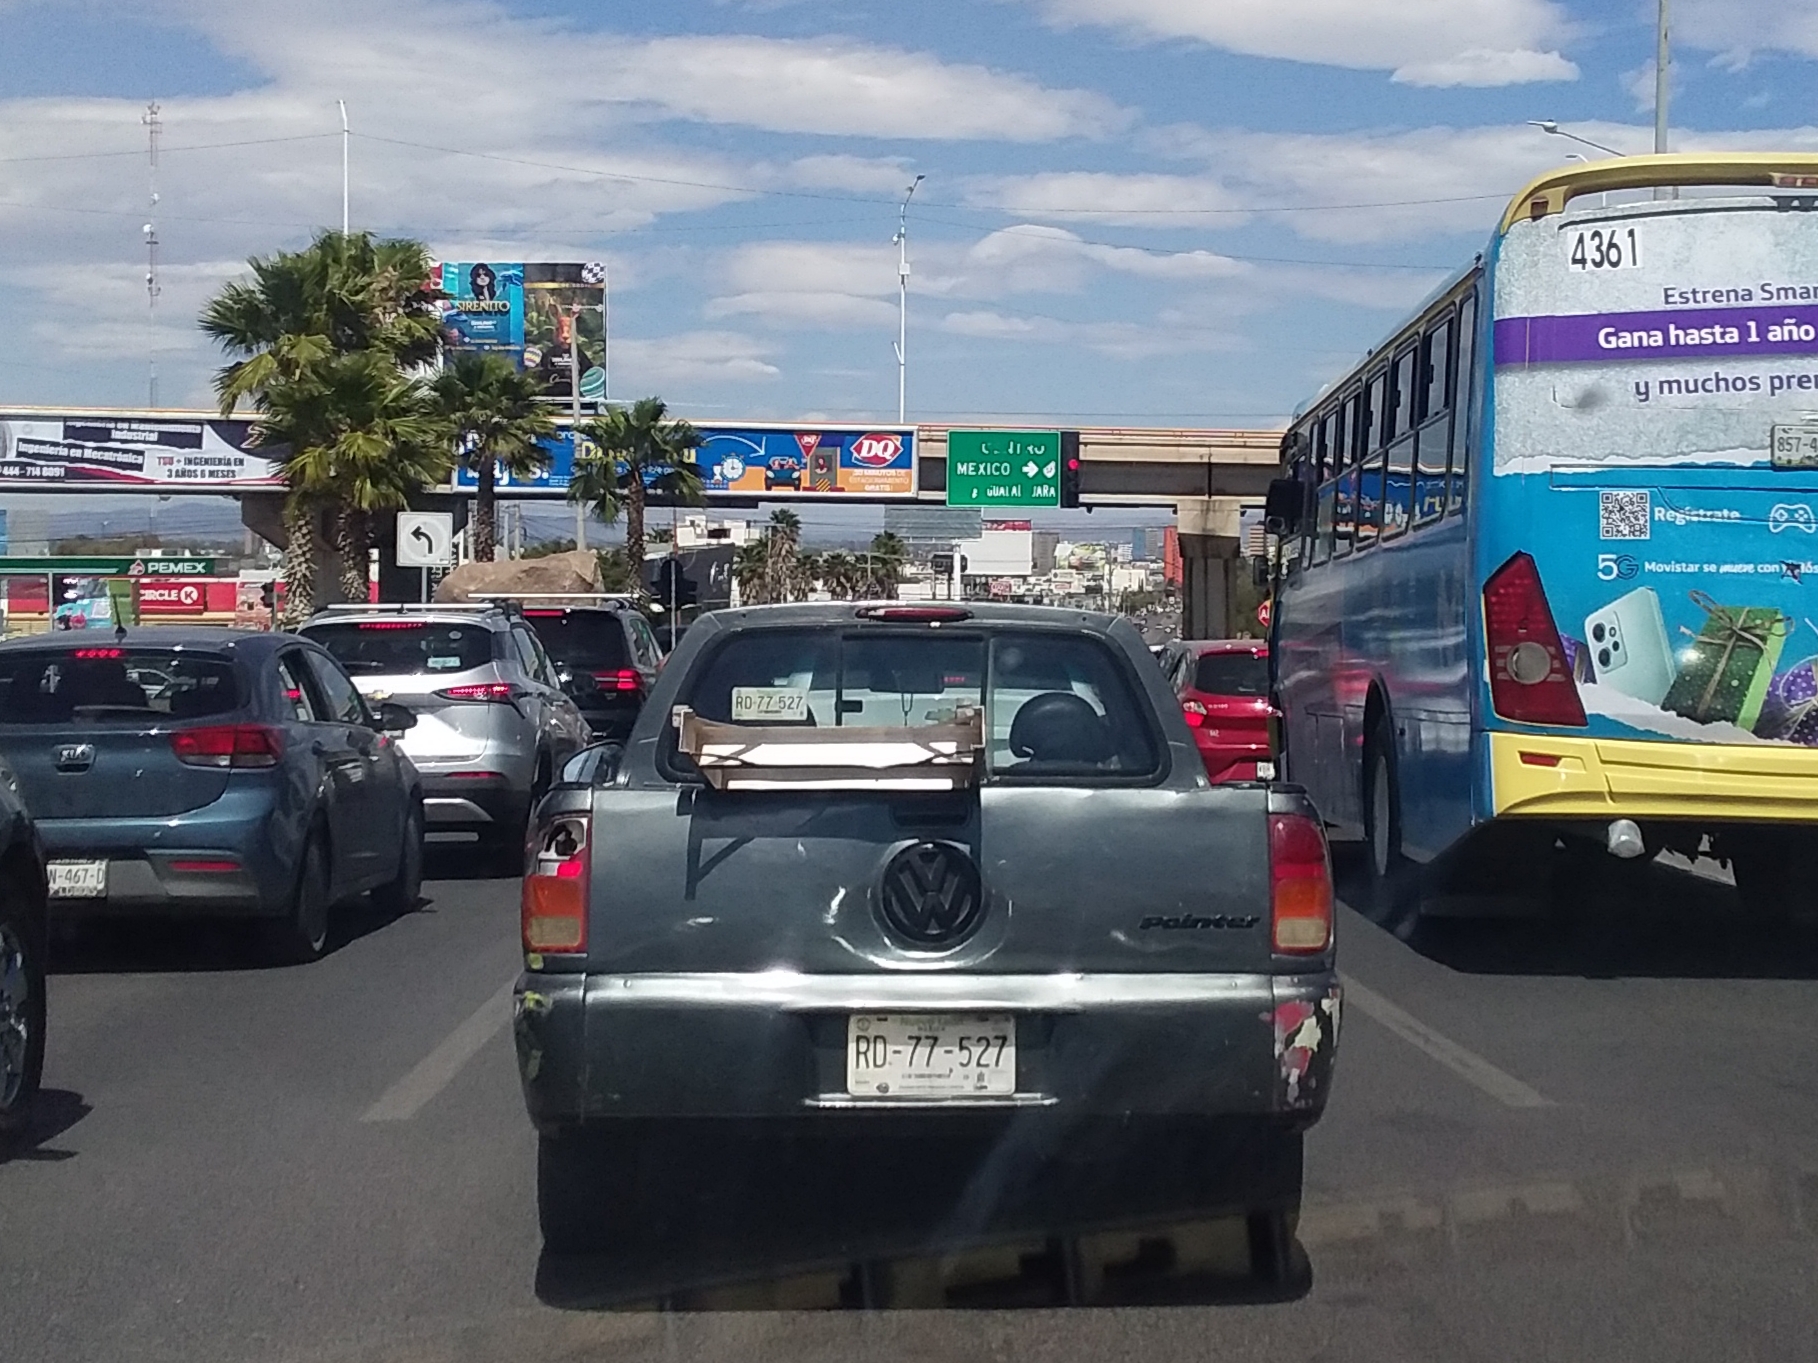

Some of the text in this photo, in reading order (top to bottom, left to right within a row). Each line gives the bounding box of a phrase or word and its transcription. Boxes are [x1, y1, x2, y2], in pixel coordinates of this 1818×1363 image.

[1571, 228, 1638, 270] 4361
[1663, 286, 1753, 305] Estrena
[456, 301, 510, 312] SIRENITO
[1599, 318, 1815, 349] Gana hasta 1 año
[1634, 380, 1650, 402] y
[1659, 372, 1761, 395] muchos
[860, 439, 895, 459] DQ
[956, 462, 1011, 476] MEXICO
[147, 562, 207, 574] PEMEX
[1597, 554, 1639, 580] 5G
[1644, 560, 1701, 573] Movistar
[1703, 563, 1718, 573] se
[1757, 563, 1780, 573] con
[855, 1034, 1008, 1069] RD-77-527
